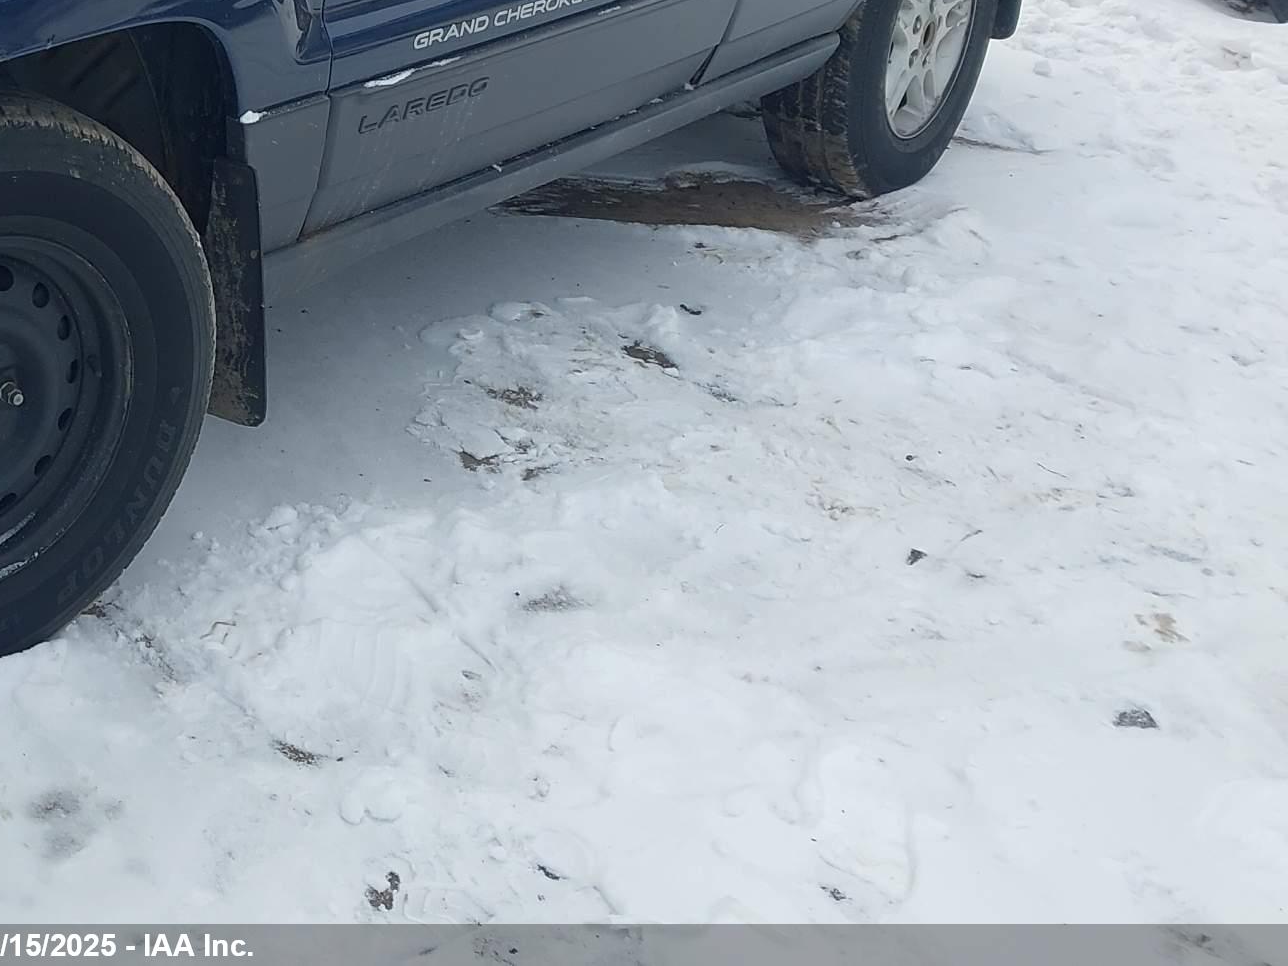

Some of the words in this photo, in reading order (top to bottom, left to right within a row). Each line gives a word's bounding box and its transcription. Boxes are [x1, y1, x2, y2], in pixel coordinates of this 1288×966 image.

[413, 14, 490, 50] GRAND
[357, 75, 490, 135] LAREDO
[55, 417, 179, 607] DUNLOP
